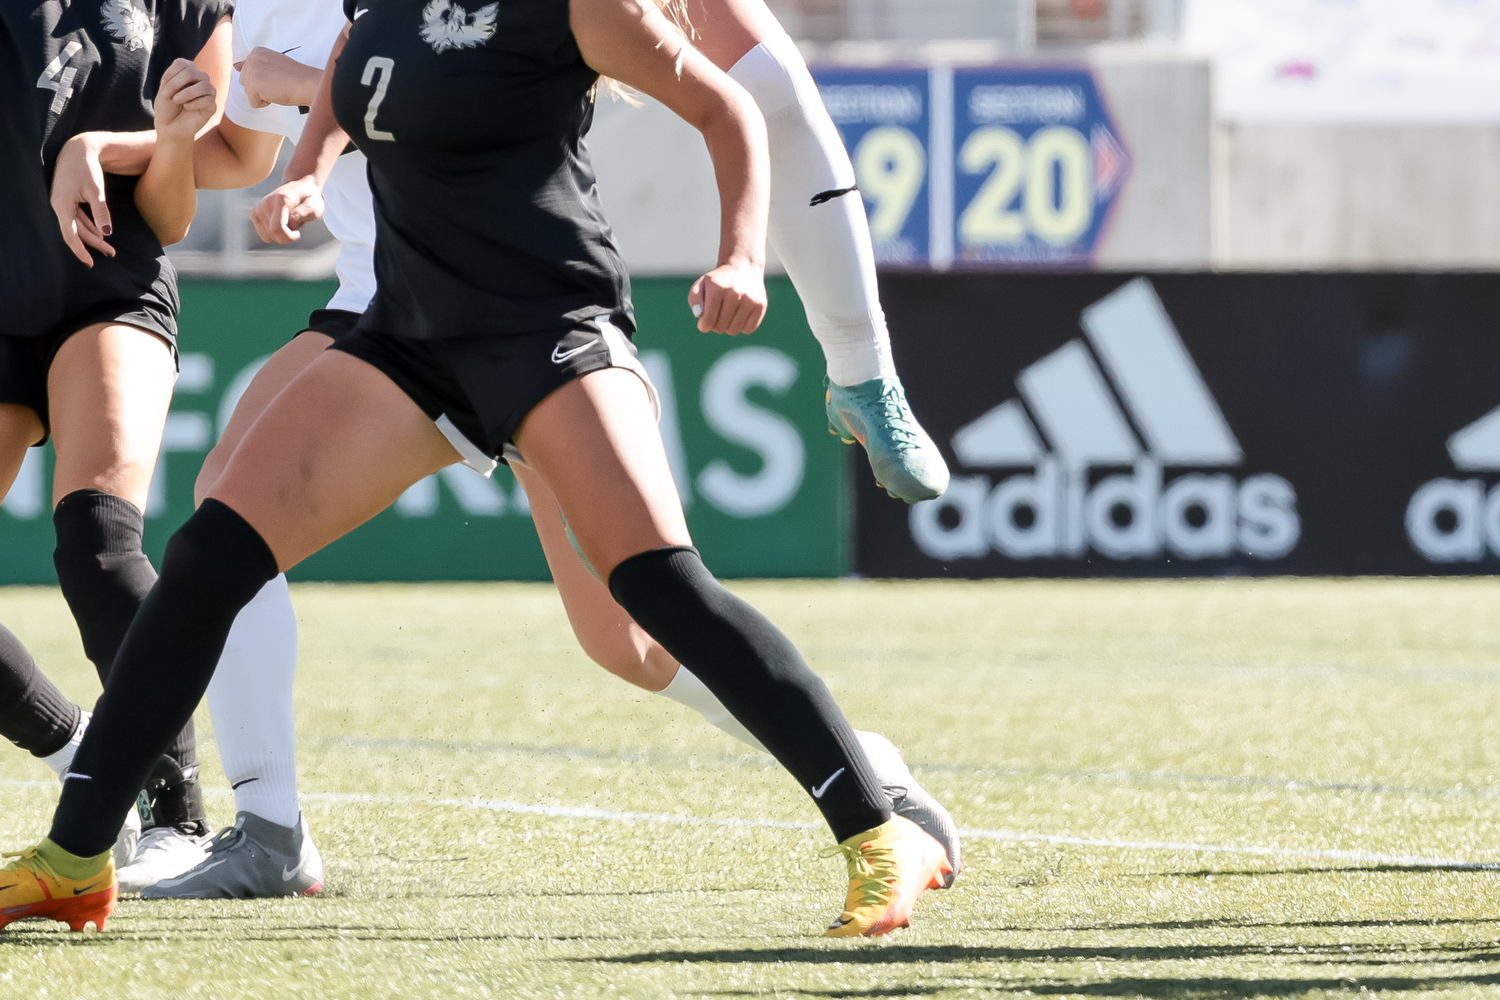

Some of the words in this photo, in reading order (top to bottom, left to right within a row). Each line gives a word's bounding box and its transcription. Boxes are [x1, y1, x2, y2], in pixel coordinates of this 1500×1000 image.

[36, 40, 83, 115] 4
[360, 55, 397, 142] 2
[848, 124, 928, 243] 9
[956, 124, 1094, 246] 20
[908, 454, 1302, 561] adidas
